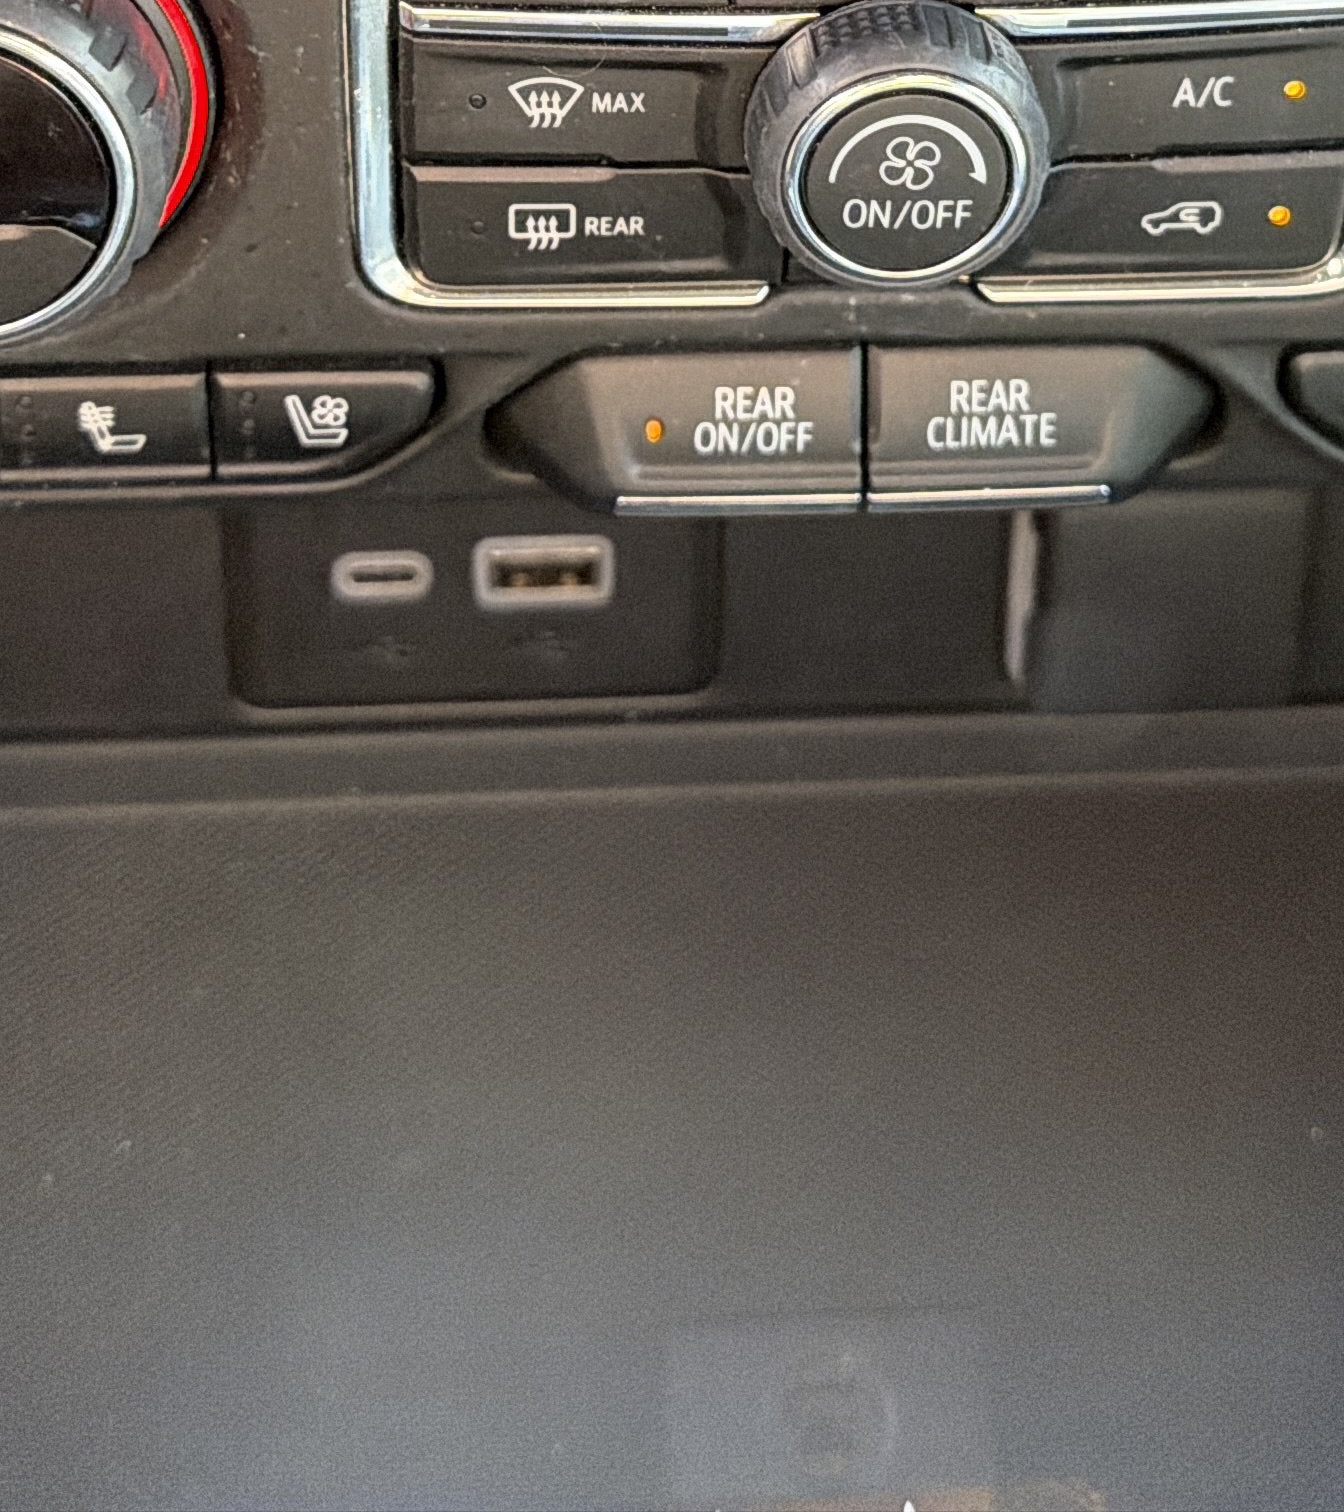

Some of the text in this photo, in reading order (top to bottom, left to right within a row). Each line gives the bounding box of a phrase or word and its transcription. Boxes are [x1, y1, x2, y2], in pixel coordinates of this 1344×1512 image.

[590, 90, 647, 115] MAX
[1172, 76, 1234, 108] A/C
[583, 214, 645, 238] REAR
[841, 197, 973, 231] ON/OFF
[713, 386, 796, 420] REAR
[948, 378, 1031, 412] REAR
[692, 420, 814, 455] ON/OFF
[926, 413, 1057, 447] CLIMATE
